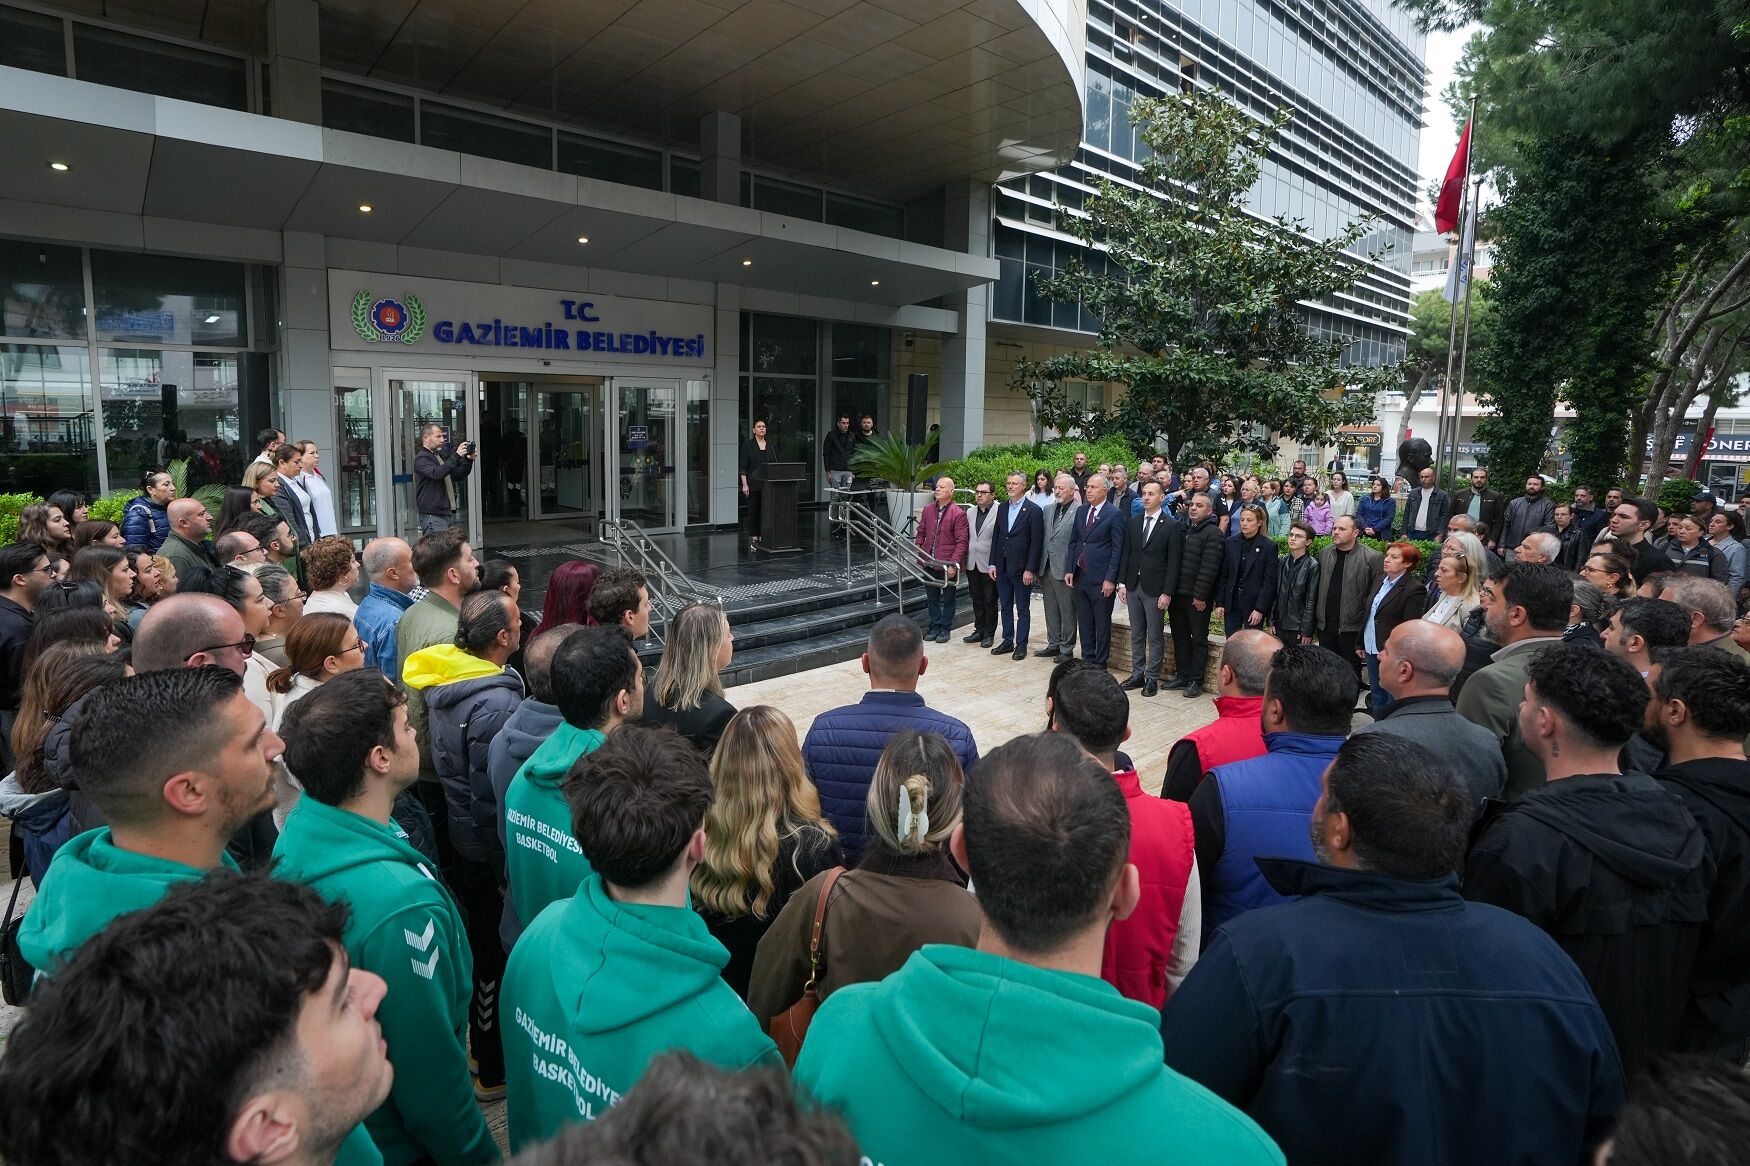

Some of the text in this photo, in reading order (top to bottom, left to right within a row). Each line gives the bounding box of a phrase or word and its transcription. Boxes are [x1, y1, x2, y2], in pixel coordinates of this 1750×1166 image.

[433, 318, 705, 358] GAZİEMİR BELEDİYESİ
[1445, 446, 1470, 454] BRIŞ
[1690, 437, 1750, 451] ÖNER
[515, 831, 558, 864] BASKETBOL
[567, 1045, 623, 1108] BELEDİYE
